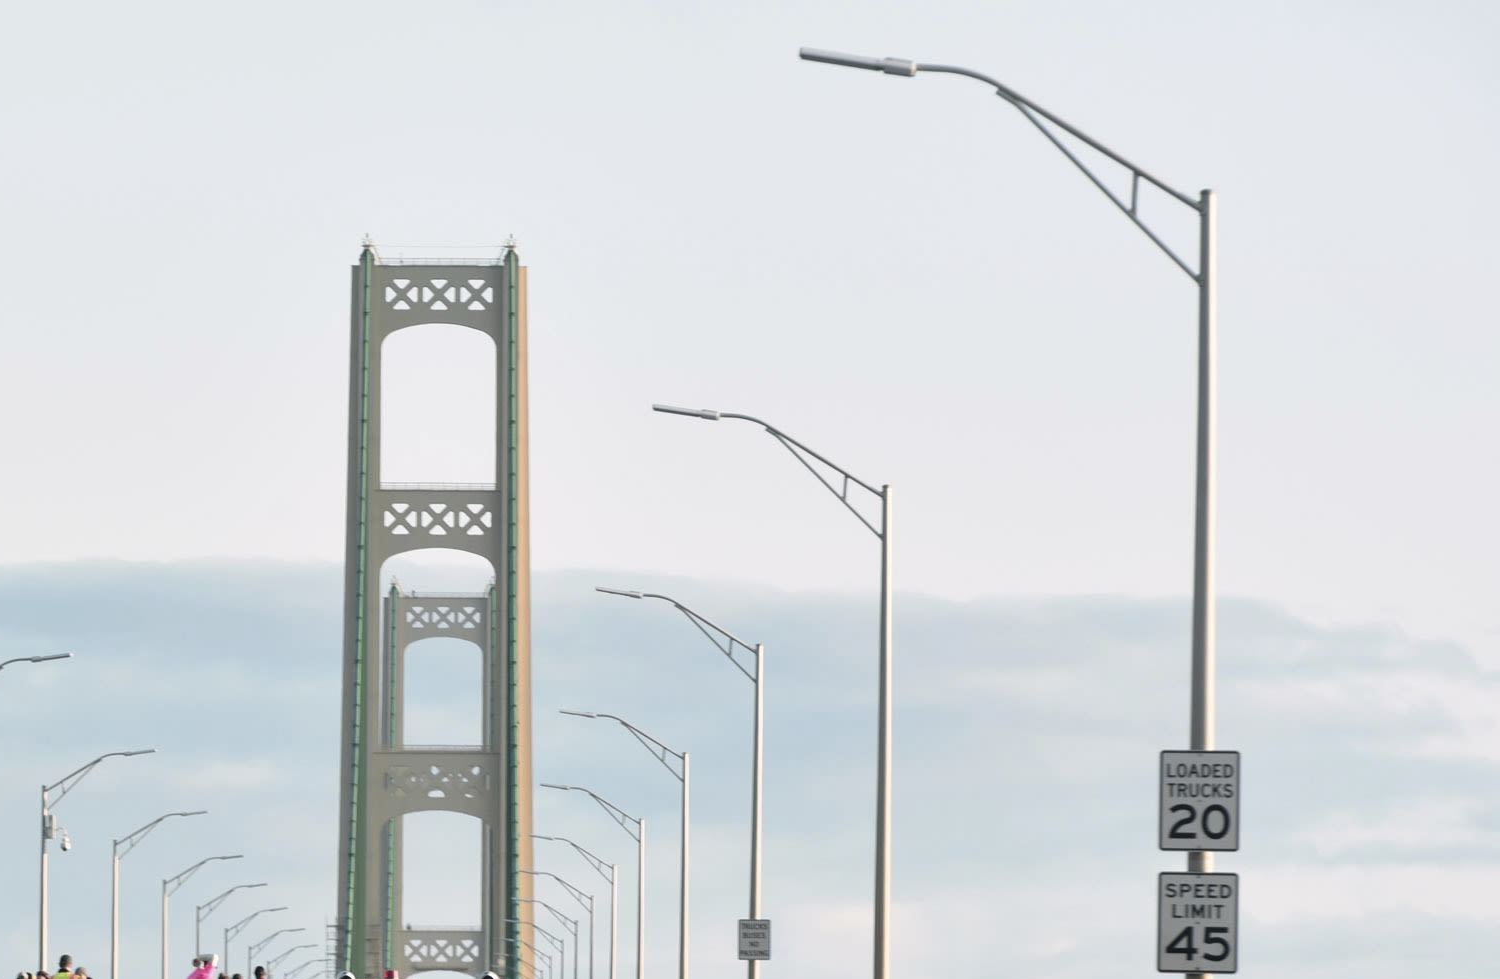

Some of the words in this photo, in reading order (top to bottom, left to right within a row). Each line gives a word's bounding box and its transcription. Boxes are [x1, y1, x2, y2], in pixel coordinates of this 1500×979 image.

[1166, 763, 1234, 779] LOADED
[1167, 783, 1234, 798] TRUCKS
[1168, 804, 1230, 840] 20
[1165, 883, 1232, 899] SPEED
[1171, 904, 1225, 919] LIMIT
[1165, 926, 1230, 962] 45
